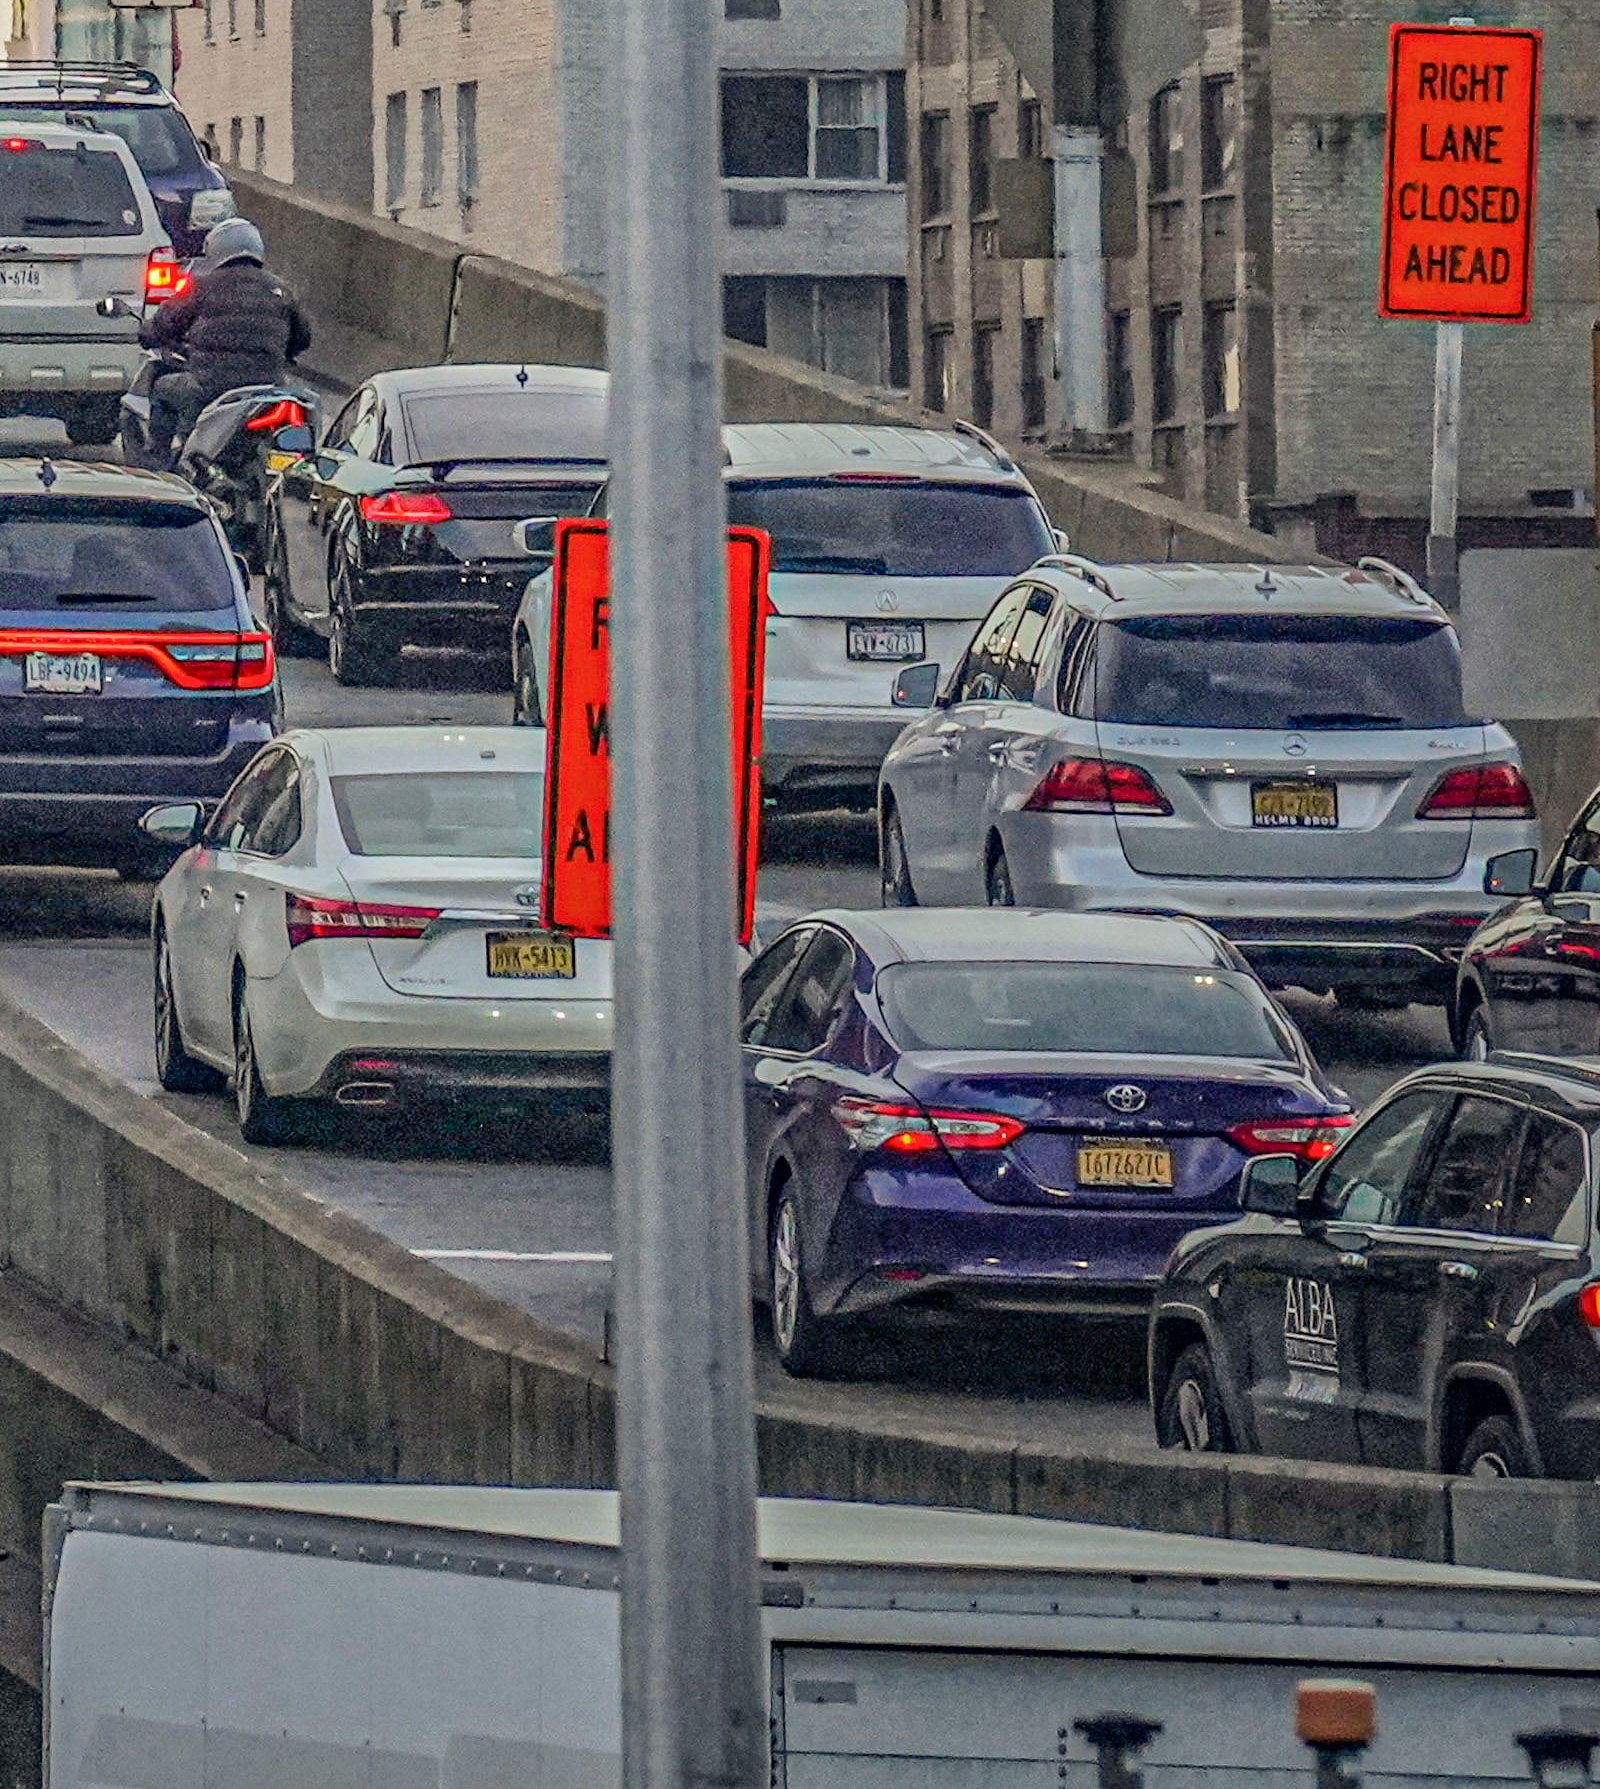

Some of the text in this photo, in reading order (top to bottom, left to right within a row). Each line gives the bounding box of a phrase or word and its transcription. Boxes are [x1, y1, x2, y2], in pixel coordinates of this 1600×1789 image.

[1418, 62, 1509, 103] RIGHT
[1420, 123, 1505, 164] LANE
[1399, 182, 1521, 225] CLOSED
[1403, 243, 1511, 285] AHEAD
[1284, 1277, 1338, 1338] ALBA
